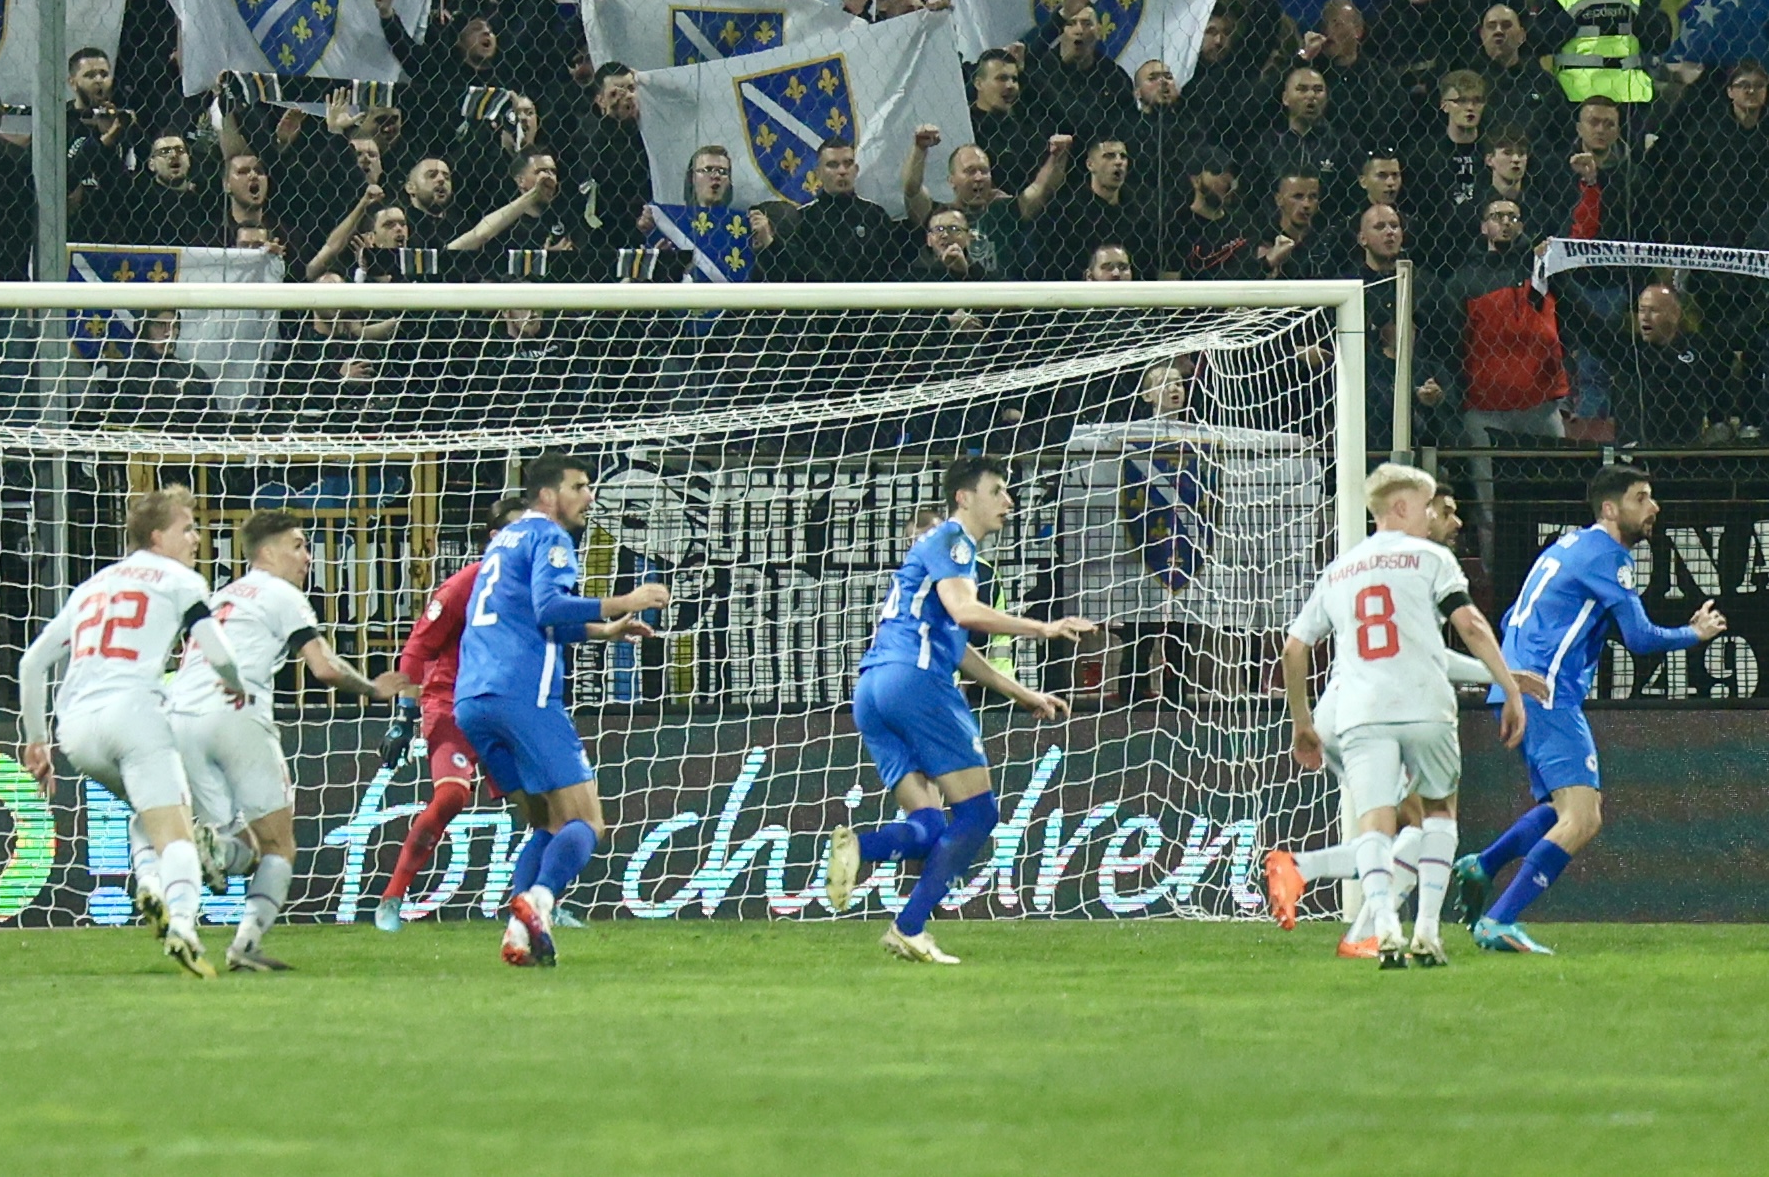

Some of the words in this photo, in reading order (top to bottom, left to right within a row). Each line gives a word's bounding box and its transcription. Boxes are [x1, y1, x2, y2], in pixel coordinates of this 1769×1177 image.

[1563, 240, 1627, 258] BOSNA
[1647, 244, 1769, 266] HERCEGOVIN
[73, 590, 150, 662] 22
[471, 552, 500, 627] 2
[1354, 583, 1400, 662] 8
[1509, 555, 1562, 629] 17
[622, 744, 1262, 919] chidren
